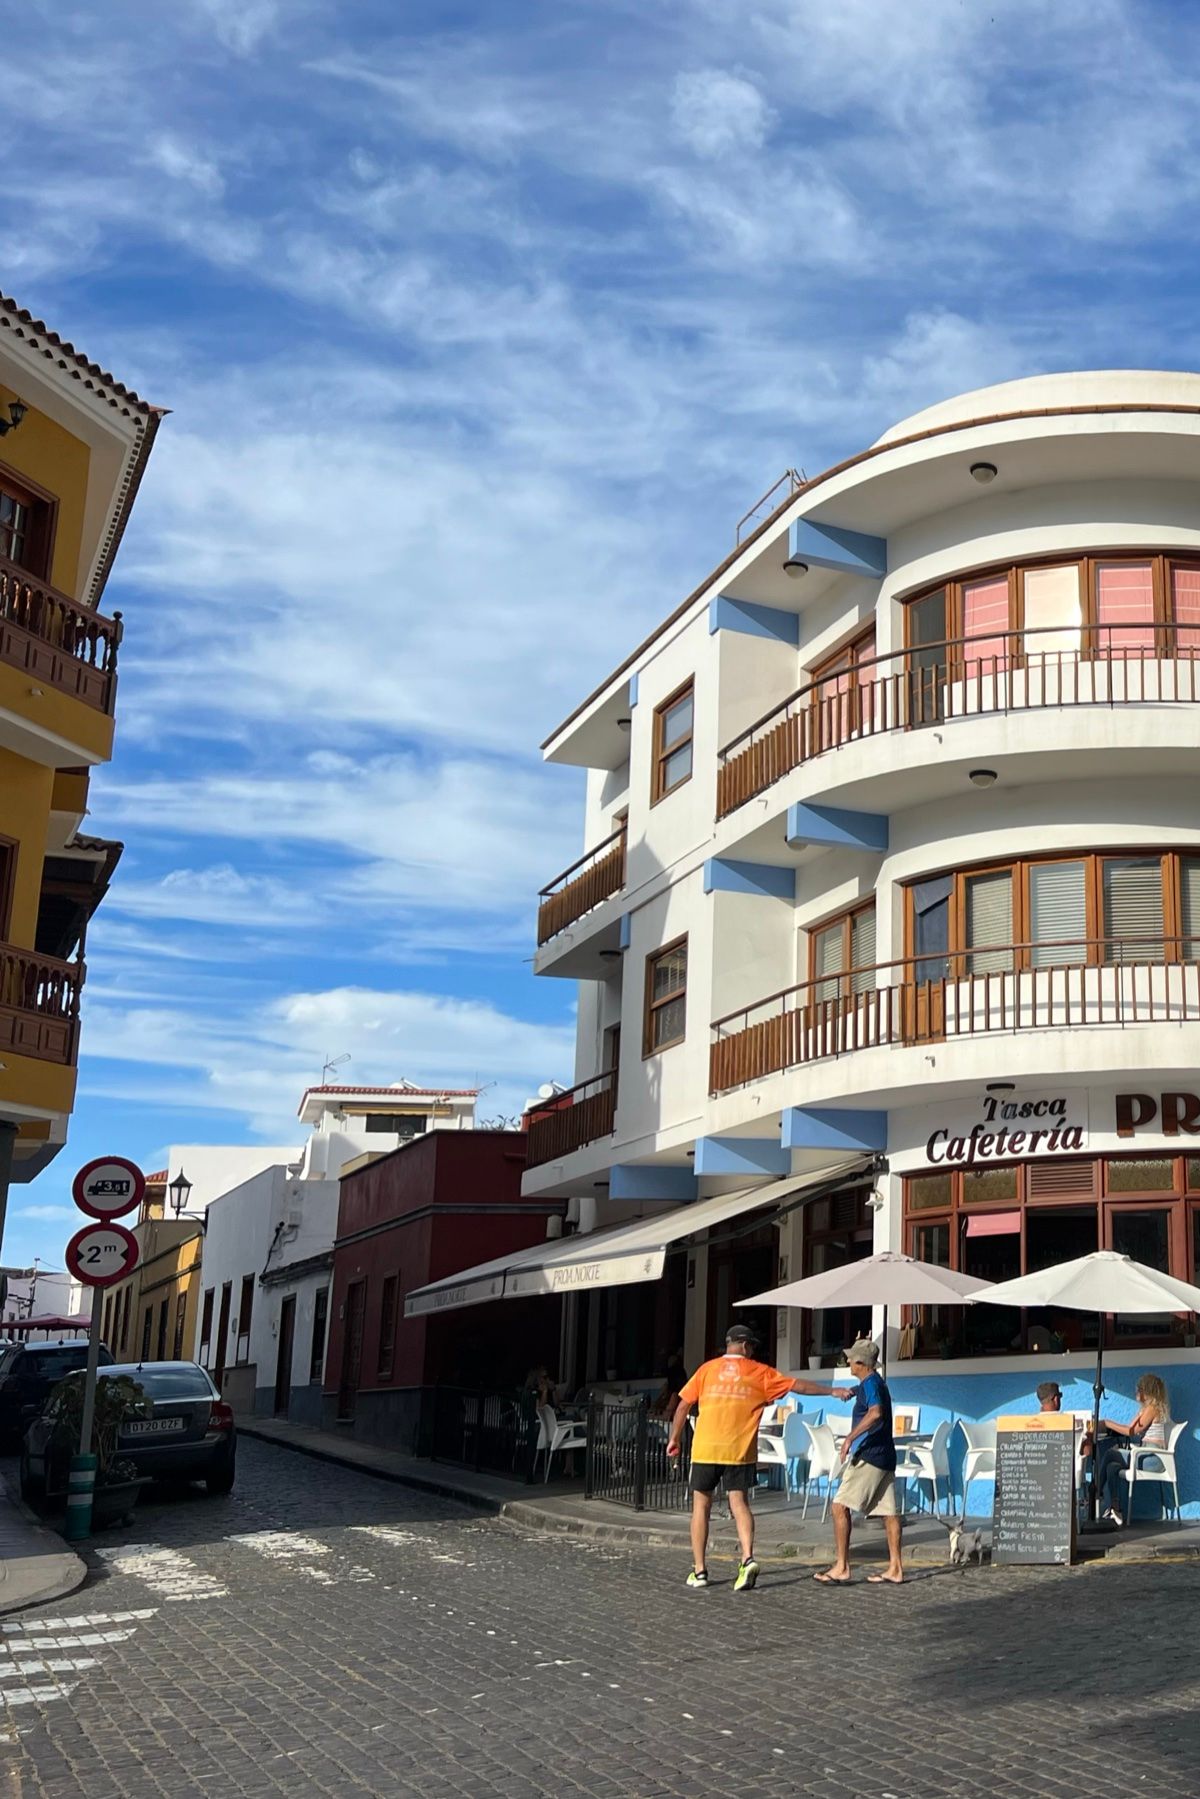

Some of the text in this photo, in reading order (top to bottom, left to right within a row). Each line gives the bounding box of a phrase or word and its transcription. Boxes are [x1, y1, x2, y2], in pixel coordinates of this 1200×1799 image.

[983, 1096, 1066, 1122] Tasca
[926, 1117, 1084, 1168] Cafetería
[132, 1421, 158, 1433] 0120
